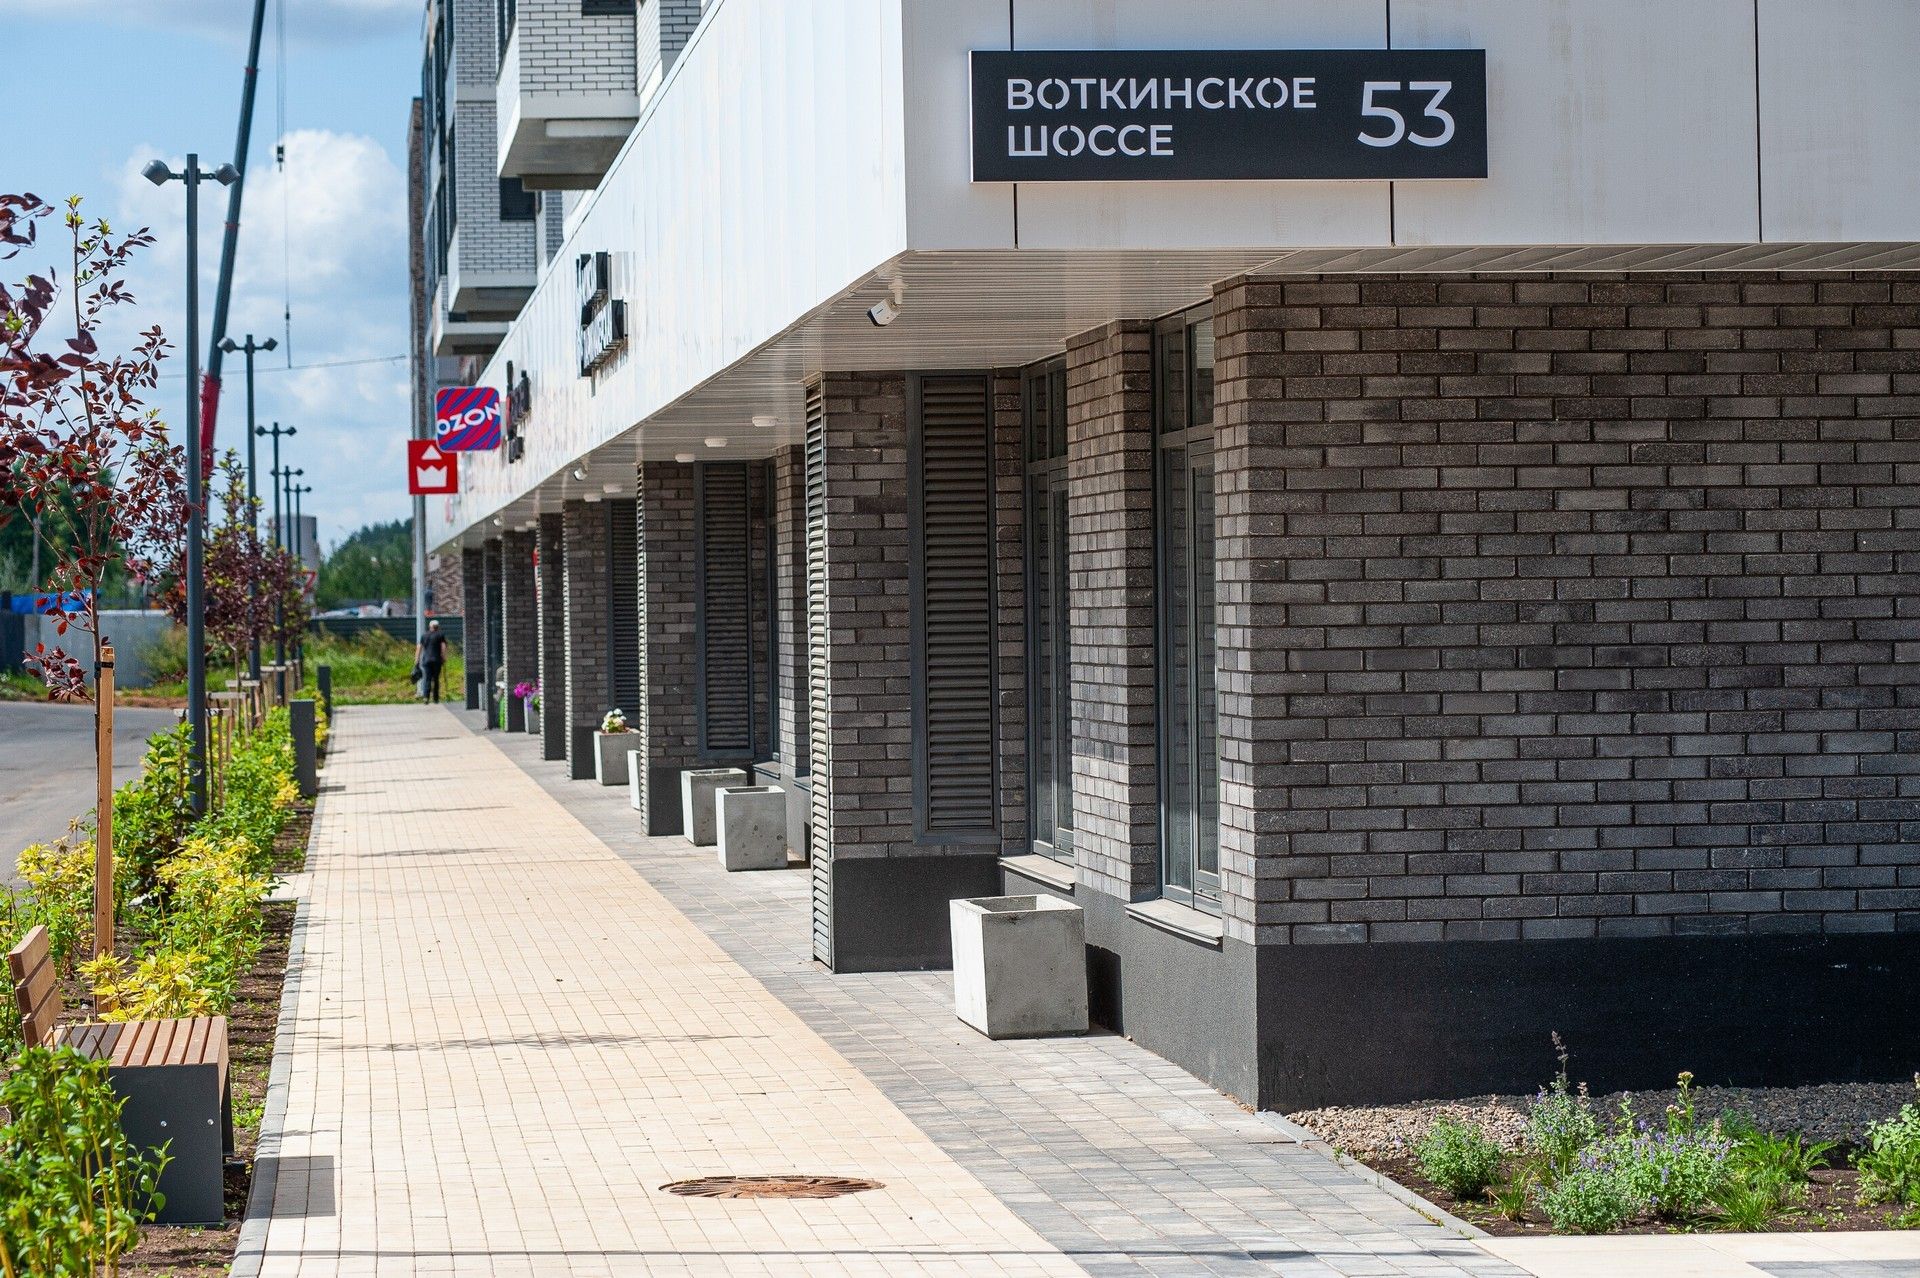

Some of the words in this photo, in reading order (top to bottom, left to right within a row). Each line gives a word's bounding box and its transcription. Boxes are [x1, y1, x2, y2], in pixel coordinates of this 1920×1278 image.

[1007, 77, 1317, 110] ВОТКИНСКОЕ
[1357, 80, 1455, 148] 53
[1008, 124, 1174, 157] ШОССЕ
[436, 402, 501, 435] OZON
